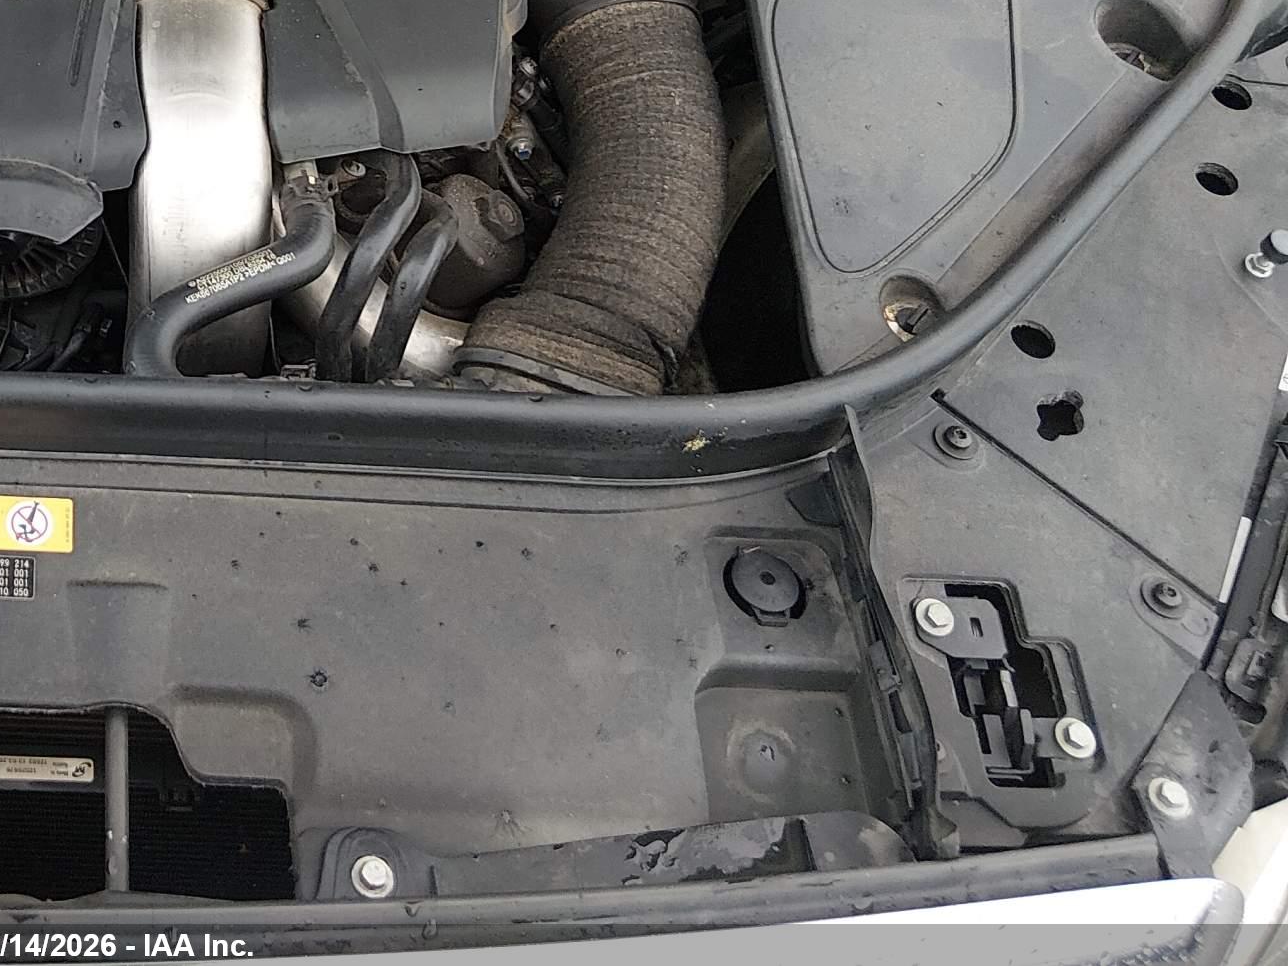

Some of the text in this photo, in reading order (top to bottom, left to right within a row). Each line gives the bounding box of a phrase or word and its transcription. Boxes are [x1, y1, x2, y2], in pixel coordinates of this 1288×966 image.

[14, 559, 29, 568] 214
[14, 569, 29, 578] 001
[13, 578, 28, 587] 001
[13, 588, 29, 597] 050
